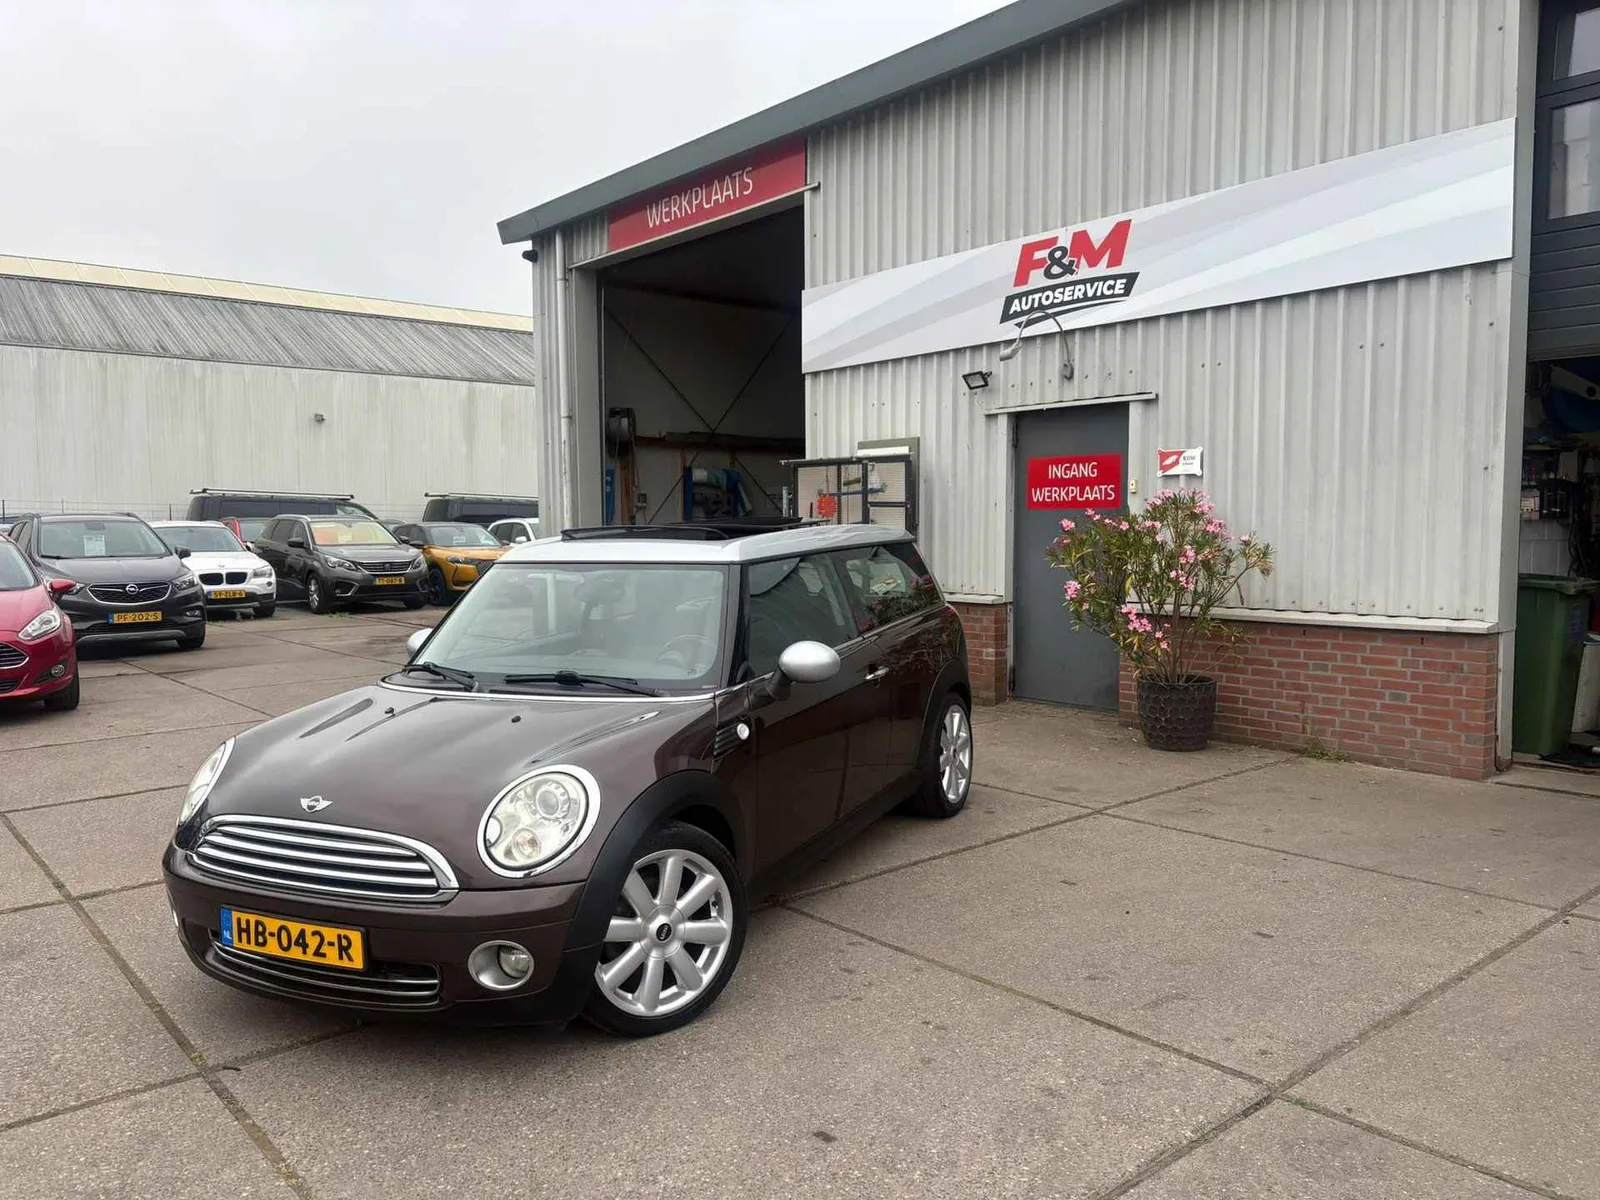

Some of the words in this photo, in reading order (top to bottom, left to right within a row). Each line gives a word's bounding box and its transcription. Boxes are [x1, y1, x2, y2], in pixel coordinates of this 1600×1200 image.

[646, 166, 753, 228] WERKPLAATS
[1013, 218, 1132, 287] F&M
[1008, 278, 1127, 314] AUTOSERVICE
[1048, 461, 1098, 479] INGANG
[1031, 484, 1115, 502] WERKPLAATS
[116, 612, 159, 622] PF-202-S
[236, 916, 354, 962] HB-042-R
